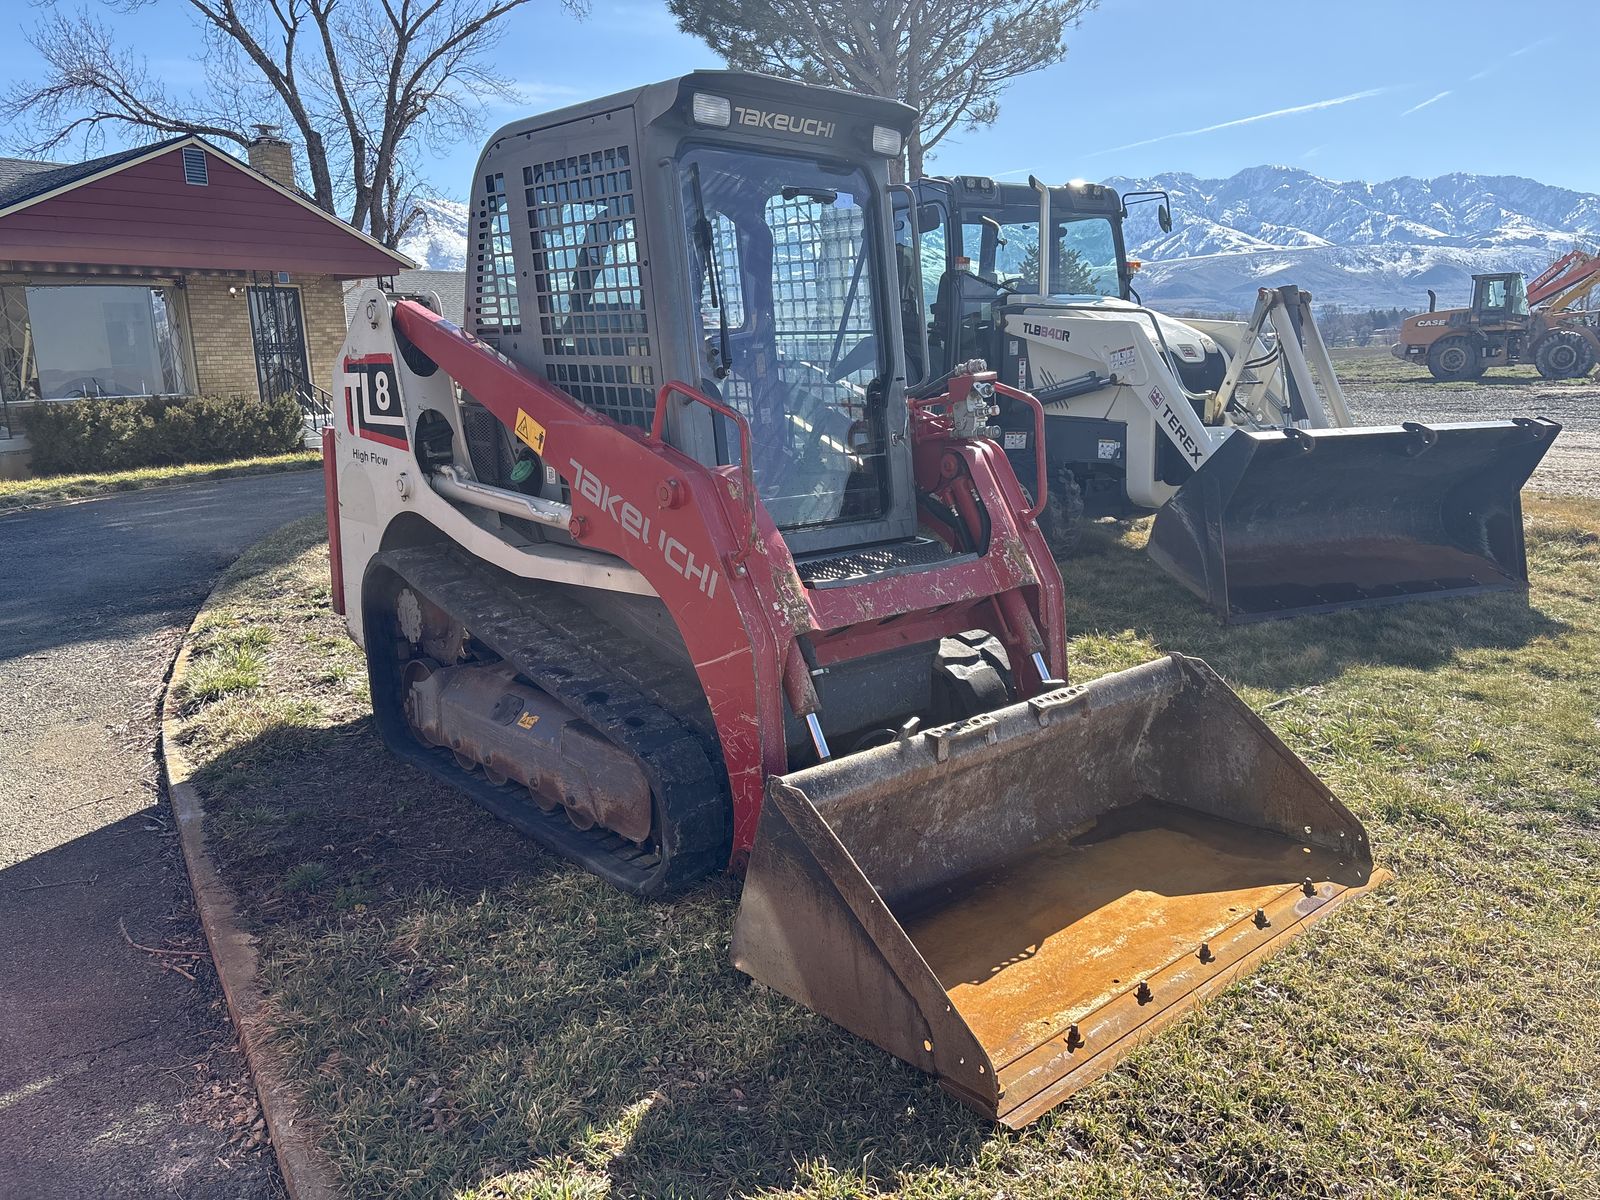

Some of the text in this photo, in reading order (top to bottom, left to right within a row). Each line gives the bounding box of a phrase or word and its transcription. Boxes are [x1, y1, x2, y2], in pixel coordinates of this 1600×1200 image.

[1416, 319, 1446, 327] CASE
[1162, 403, 1203, 465] TEREX
[352, 448, 388, 466] High Flow
